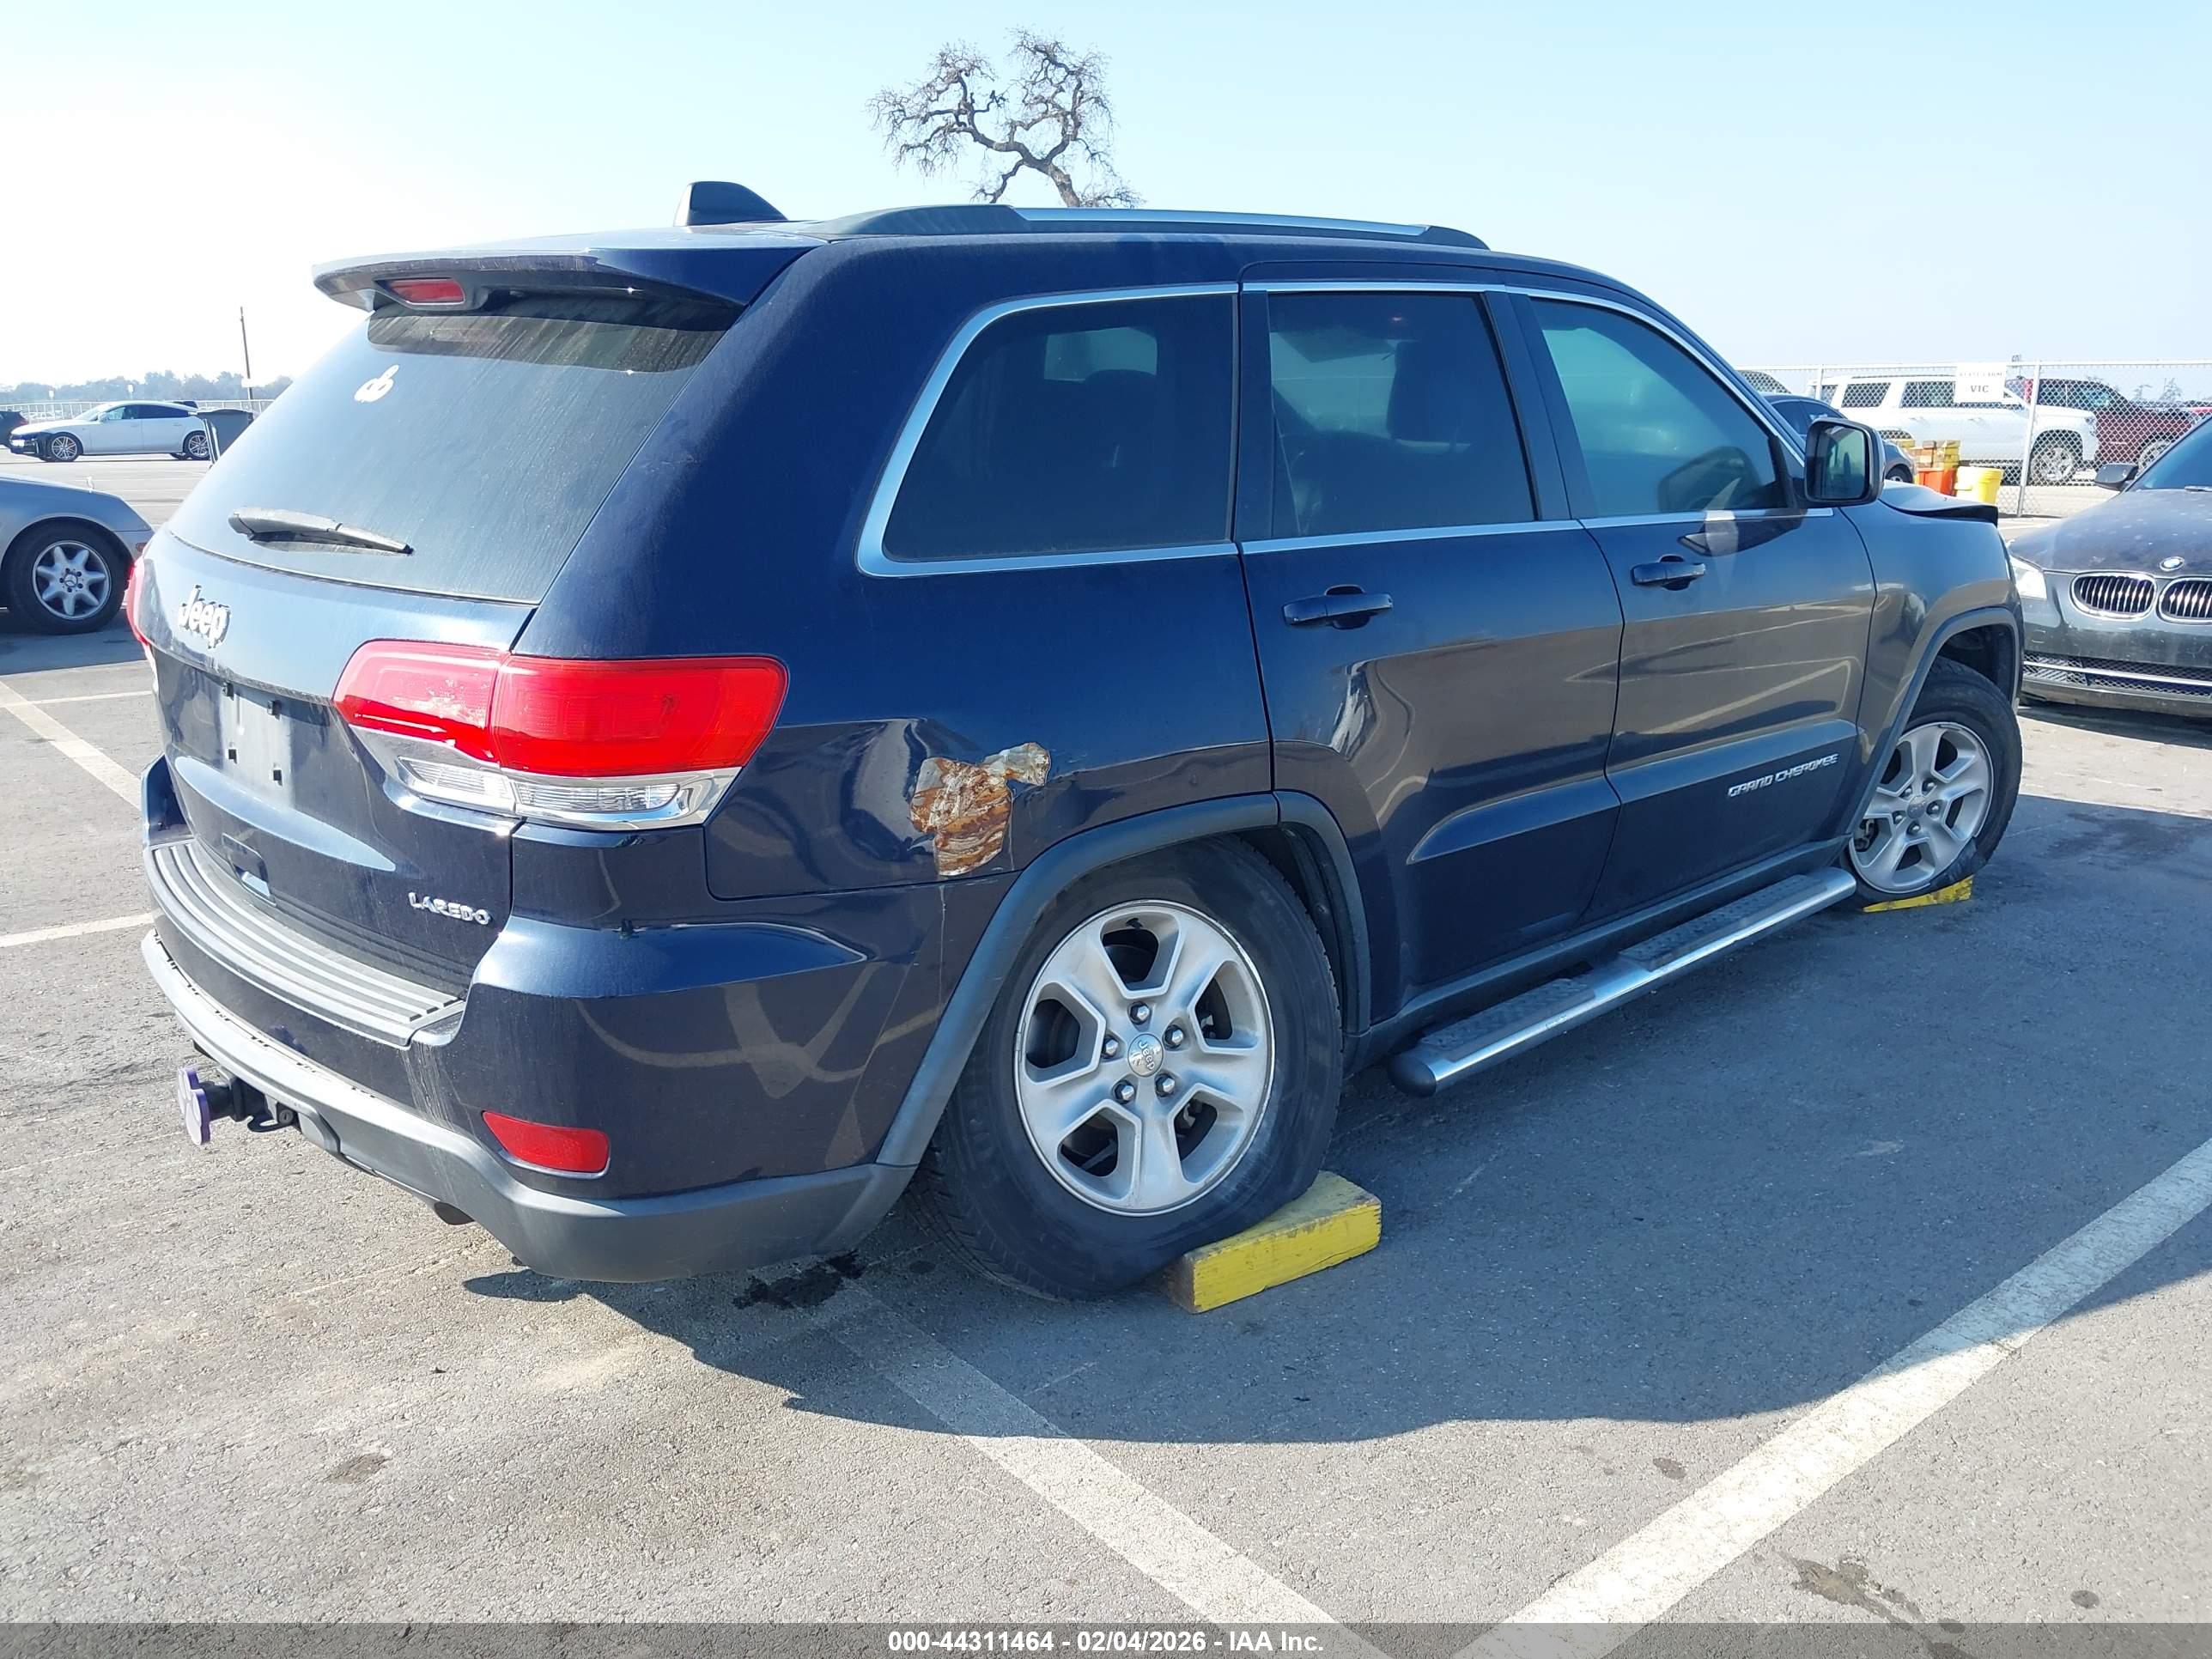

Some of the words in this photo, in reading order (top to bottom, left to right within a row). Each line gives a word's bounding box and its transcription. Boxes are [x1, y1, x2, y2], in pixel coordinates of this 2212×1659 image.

[178, 584, 231, 649] Jeep
[1727, 774, 1775, 797] GRAND
[1774, 753, 1839, 783] CHEROKEE
[408, 891, 491, 926] LAREDO
[1138, 1040, 1155, 1070] Jeep
